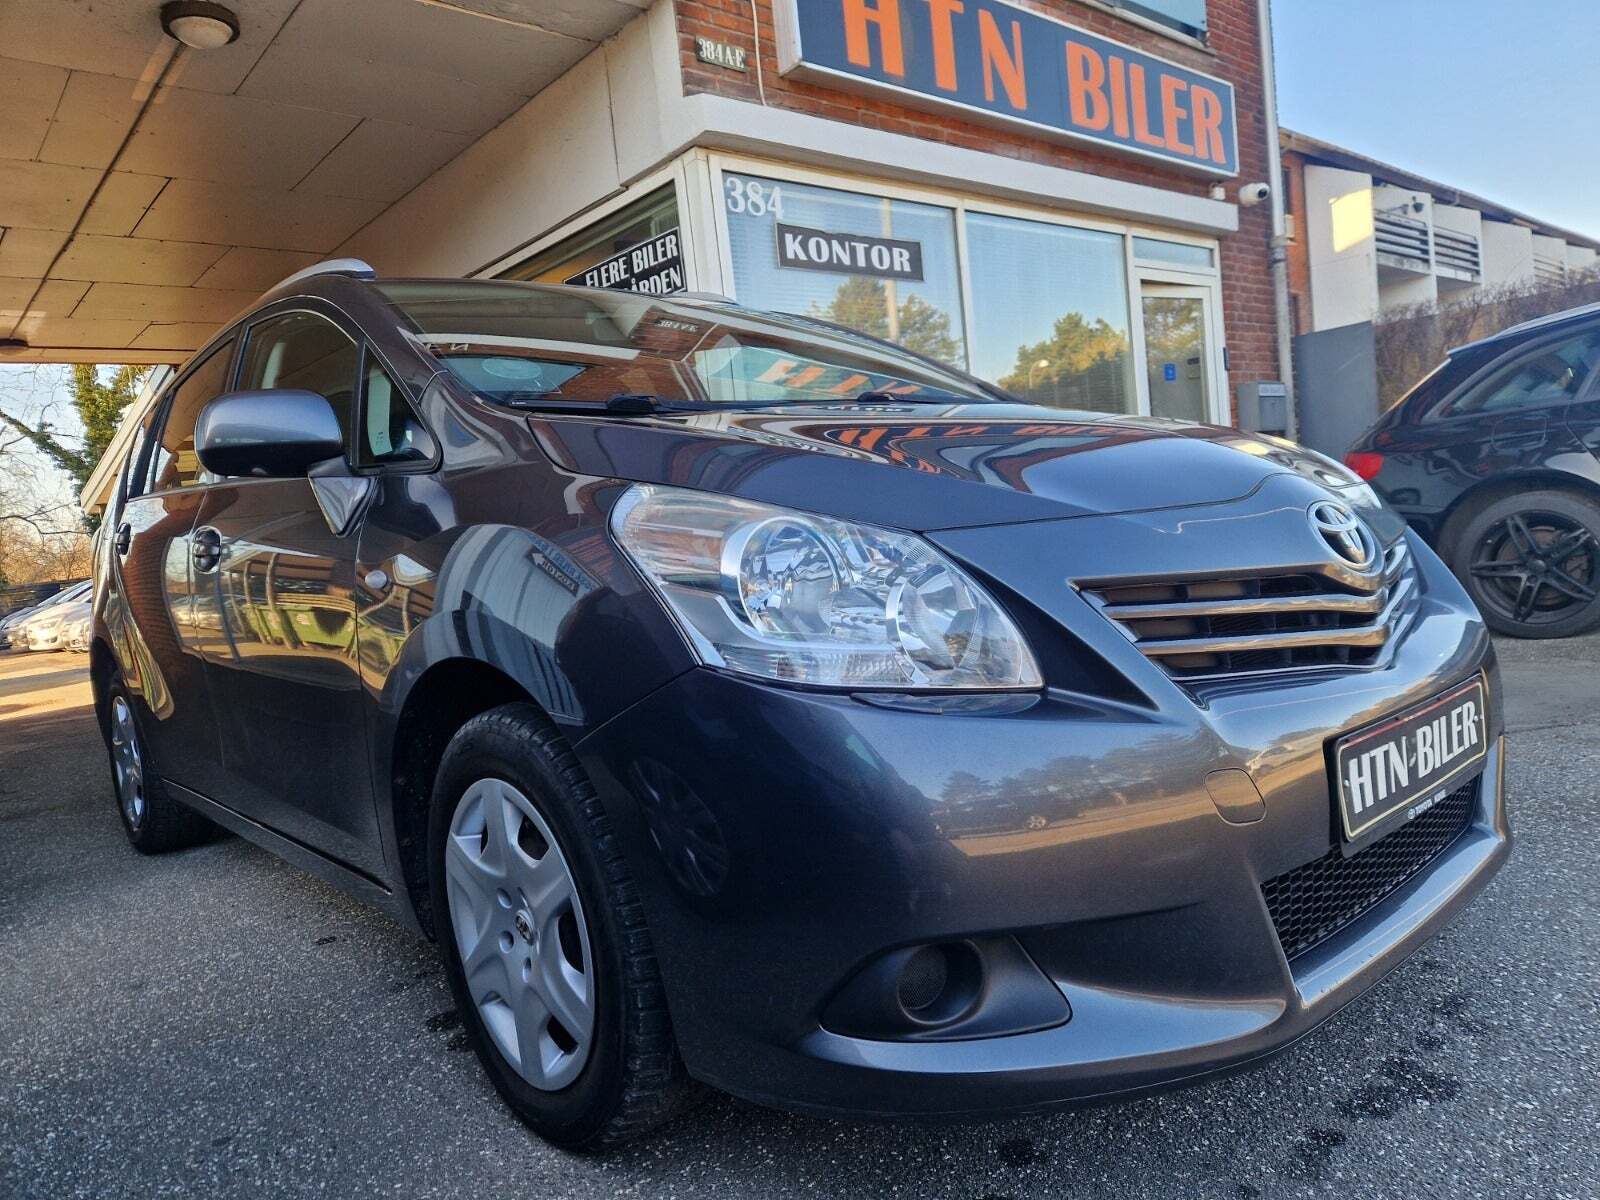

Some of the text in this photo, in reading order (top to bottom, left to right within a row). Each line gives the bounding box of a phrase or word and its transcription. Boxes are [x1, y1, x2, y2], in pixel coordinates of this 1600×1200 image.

[842, 0, 1227, 164] HTN BILER
[725, 177, 784, 219] 384
[631, 234, 678, 274] BILER
[784, 233, 912, 273] KONTOR
[1348, 701, 1478, 814] HTN BILER
